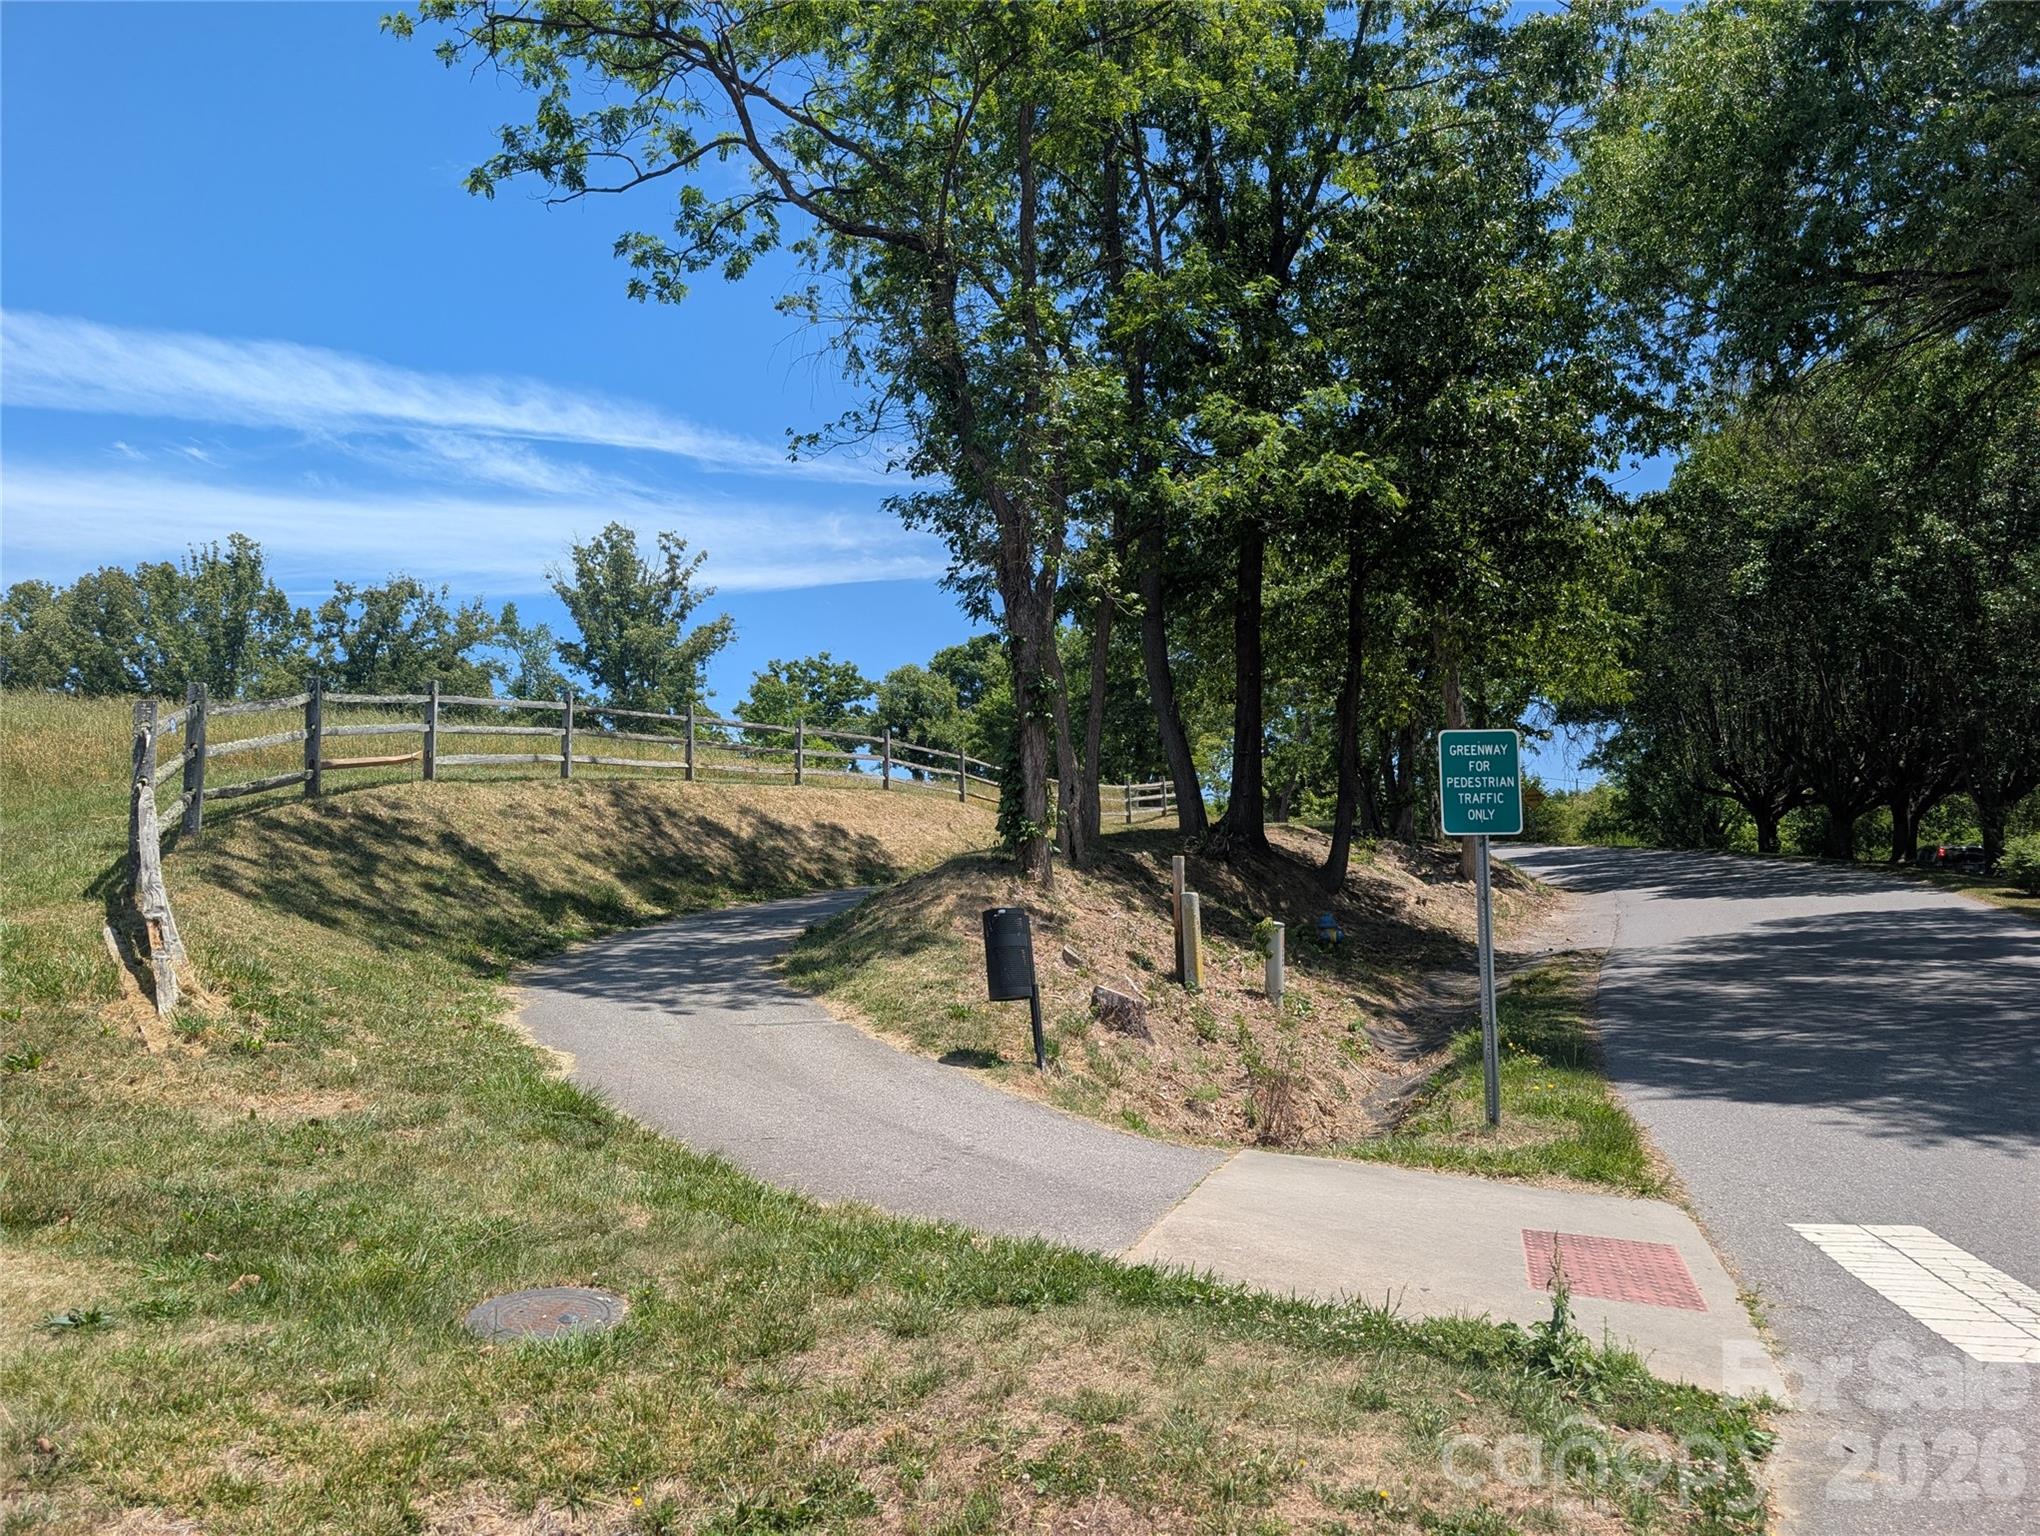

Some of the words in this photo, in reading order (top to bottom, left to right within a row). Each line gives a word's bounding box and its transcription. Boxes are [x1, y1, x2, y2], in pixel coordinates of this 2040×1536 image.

[1449, 744, 1508, 756] GREENWAY
[1468, 760, 1490, 772] FOR
[1446, 776, 1515, 788] PEDESTRIAN
[1458, 792, 1504, 804] TRAFFIC
[1467, 809, 1495, 820] ONLY
